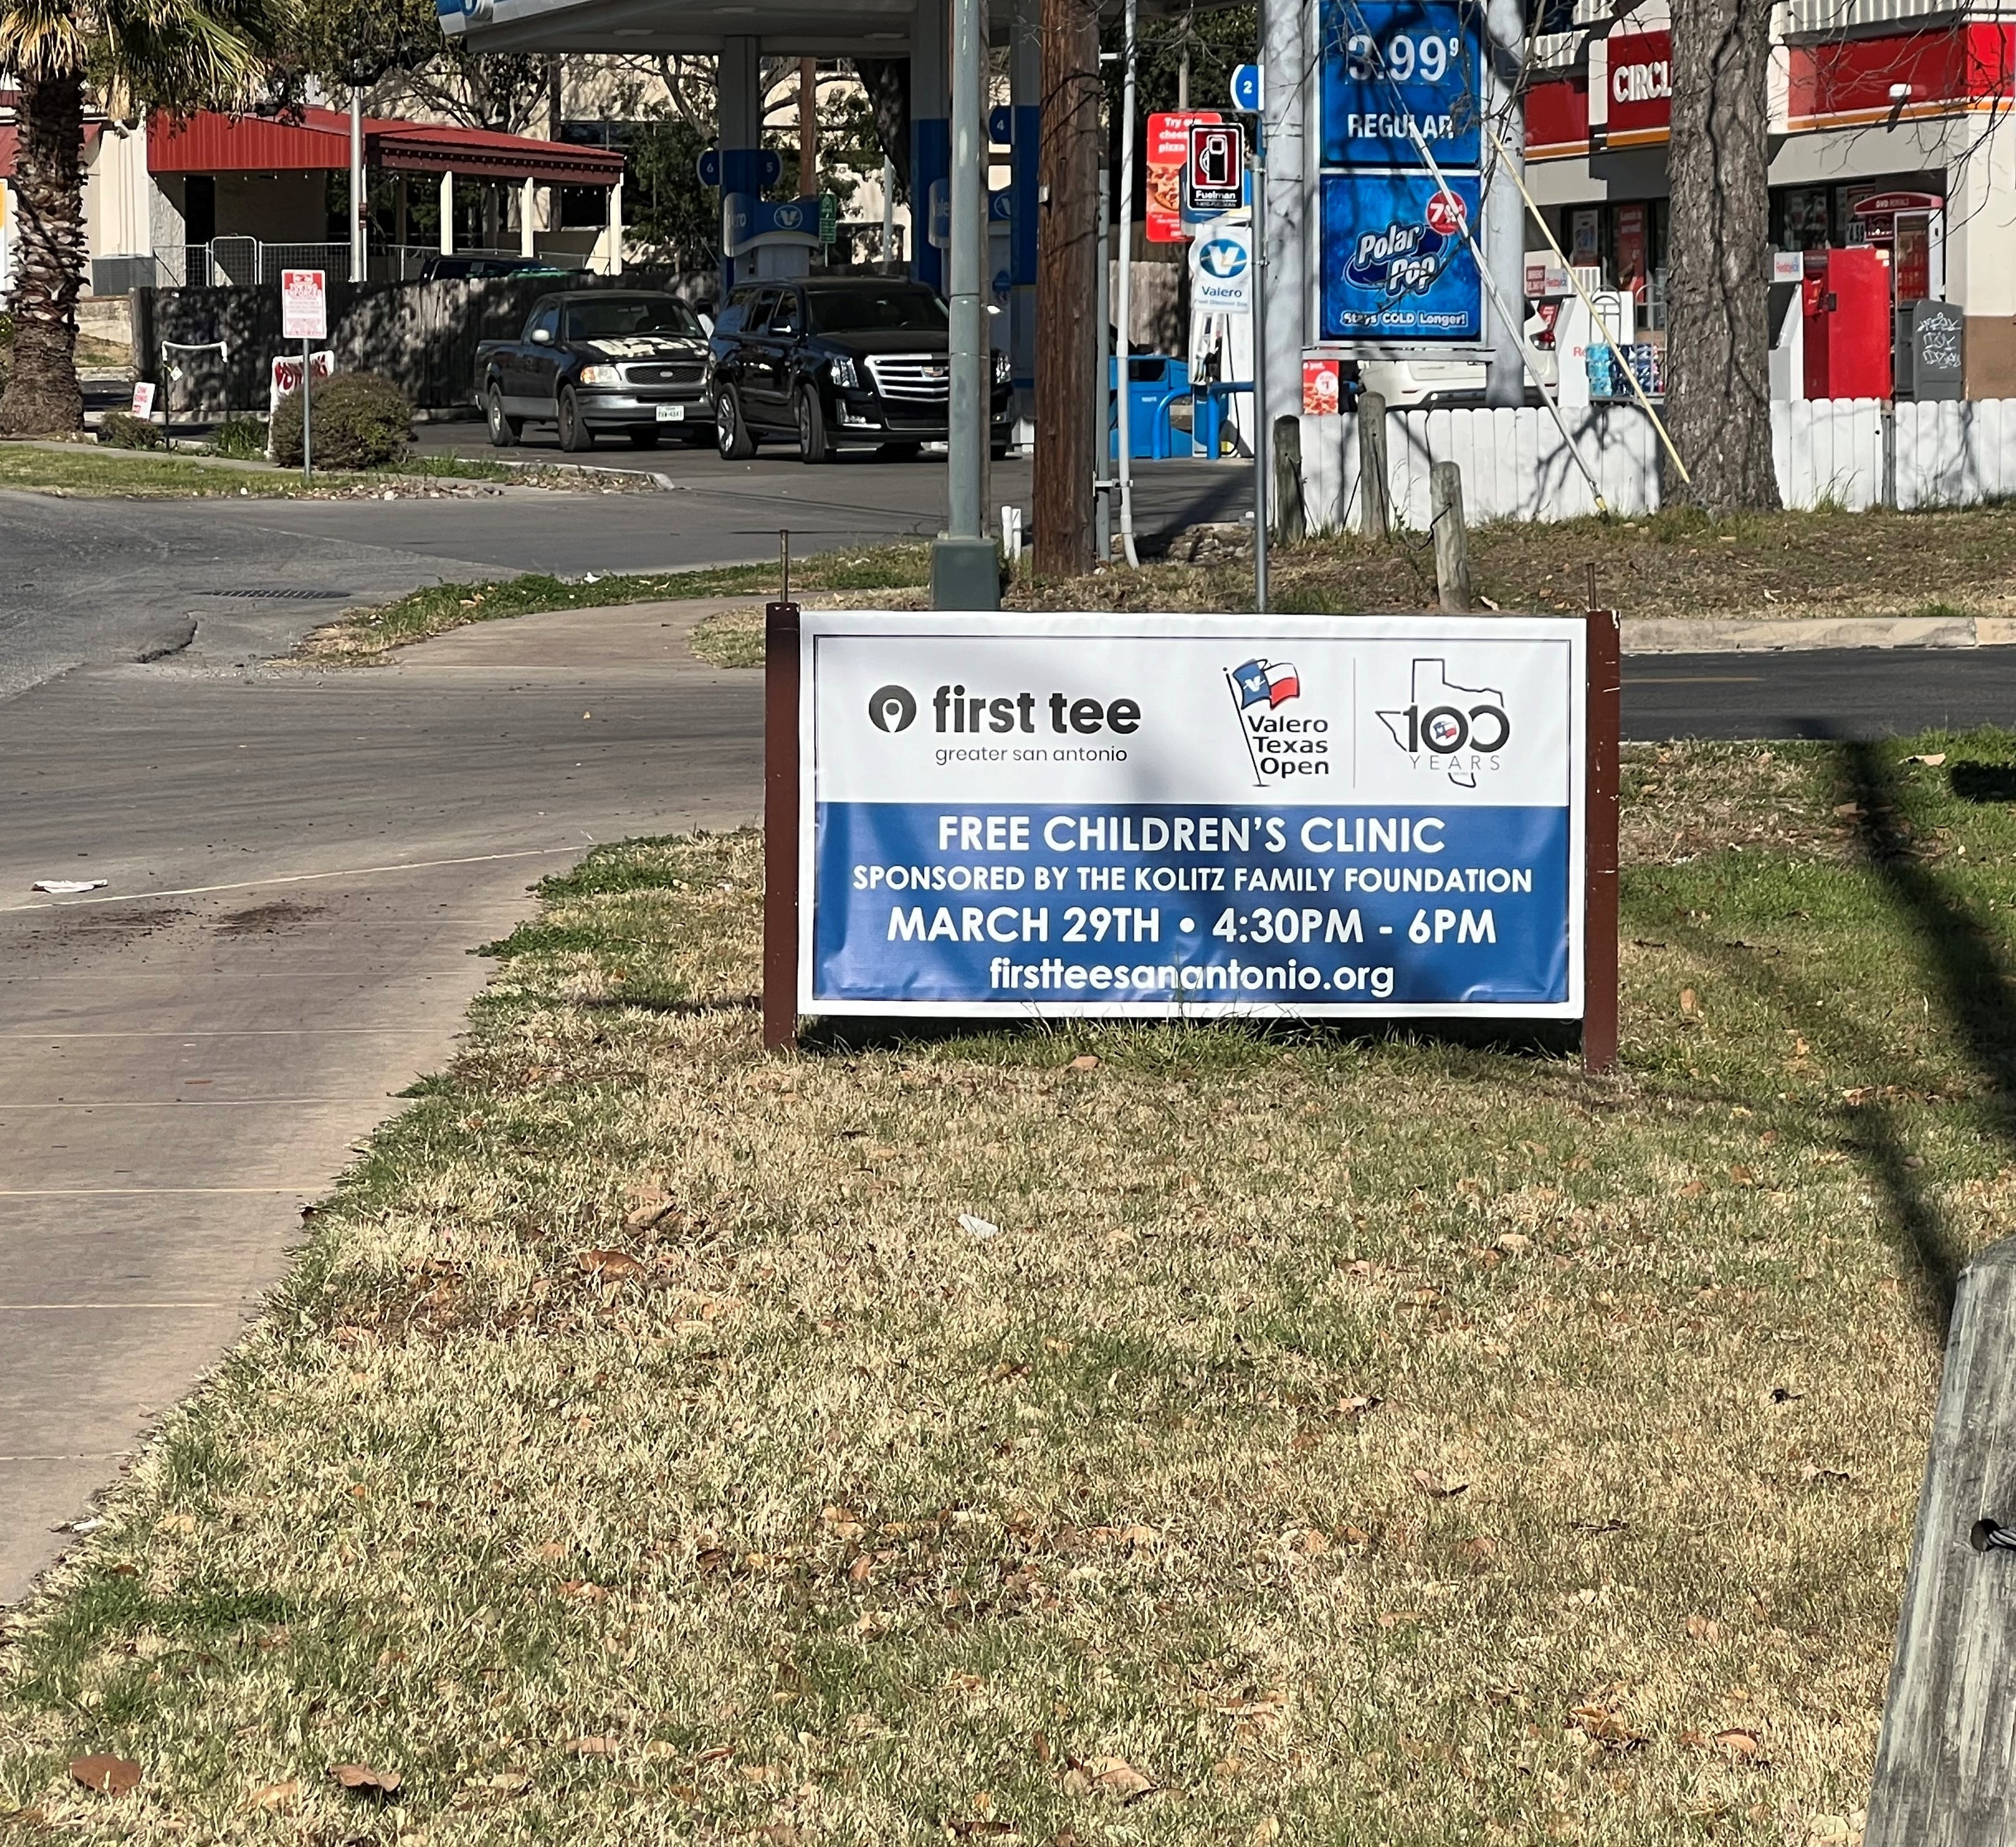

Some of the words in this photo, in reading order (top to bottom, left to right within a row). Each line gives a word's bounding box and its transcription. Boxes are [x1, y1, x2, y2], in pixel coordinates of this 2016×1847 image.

[1243, 80, 1252, 94] 2
[1612, 60, 1673, 102] CIRCL
[996, 119, 1005, 130] 4
[1164, 117, 1181, 128] Try
[1347, 113, 1454, 138] REGULAR
[1159, 130, 1190, 140] chees
[1158, 143, 1185, 153] pizza
[706, 163, 714, 173] 6
[766, 161, 774, 173] 5
[1195, 190, 1236, 199] Fuelman
[1359, 224, 1420, 264] Polar
[1389, 256, 1436, 291] Pop
[1201, 285, 1242, 298] Valero
[1383, 312, 1415, 324] COLD
[1420, 312, 1466, 326] Longer!
[932, 684, 1036, 733] first
[1048, 692, 1142, 735] tee
[1247, 715, 1328, 733] Valero
[1402, 704, 1511, 754] 100
[1252, 736, 1328, 754] Texas
[936, 747, 1008, 766] greater
[1013, 749, 1048, 762] san
[1053, 746, 1128, 762] antonio
[1409, 754, 1501, 771] YEARS
[1260, 757, 1329, 779] Open
[938, 815, 1030, 852] FREE
[1043, 815, 1287, 853] CHILDREN'S
[1300, 816, 1446, 854] CLINIC
[853, 865, 1025, 891] SPONSORED
[1035, 866, 1070, 890] BY
[1077, 867, 1126, 891] THE
[1135, 867, 1225, 892] KOLITZ
[1235, 868, 1335, 892] FAMILY
[1345, 868, 1532, 893] FOUNDATION
[886, 906, 1049, 942] MARCH
[1062, 907, 1160, 943] 29TH
[1212, 907, 1364, 943] 4:30PM
[1408, 909, 1497, 944] 6PM
[989, 957, 1394, 998] firstteesanantonio.org
